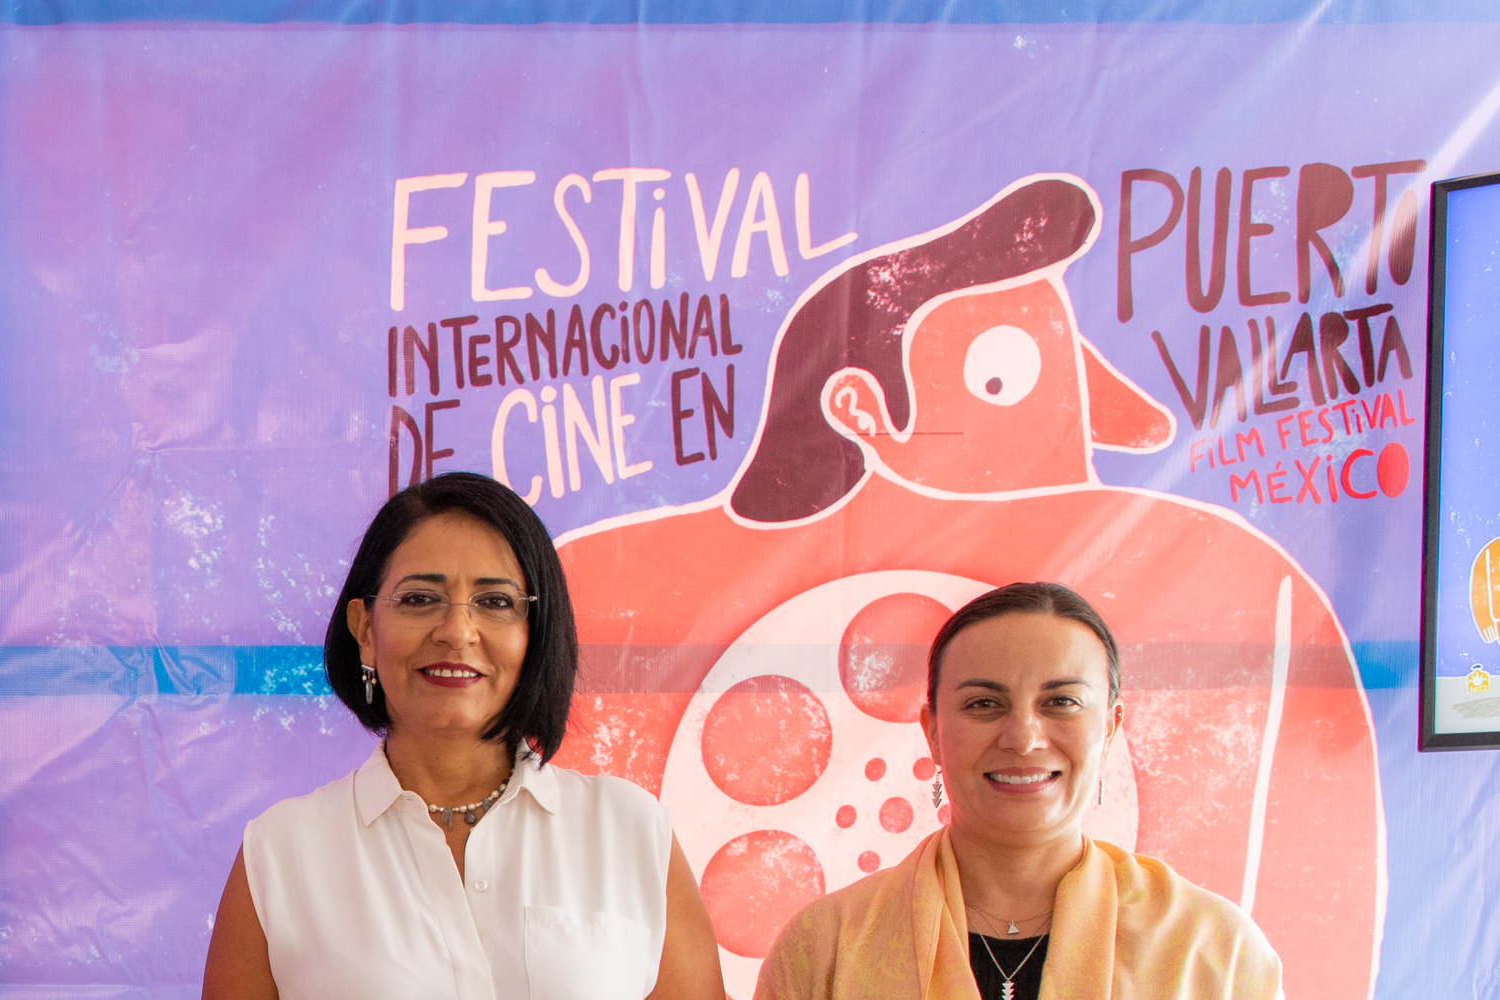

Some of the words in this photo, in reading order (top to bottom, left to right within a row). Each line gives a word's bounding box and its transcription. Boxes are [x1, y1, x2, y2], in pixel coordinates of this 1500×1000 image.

[1116, 159, 1427, 324] PUERTO
[388, 399, 461, 498] DE
[671, 364, 735, 467] EN
[1151, 303, 1414, 431] VALLARTA
